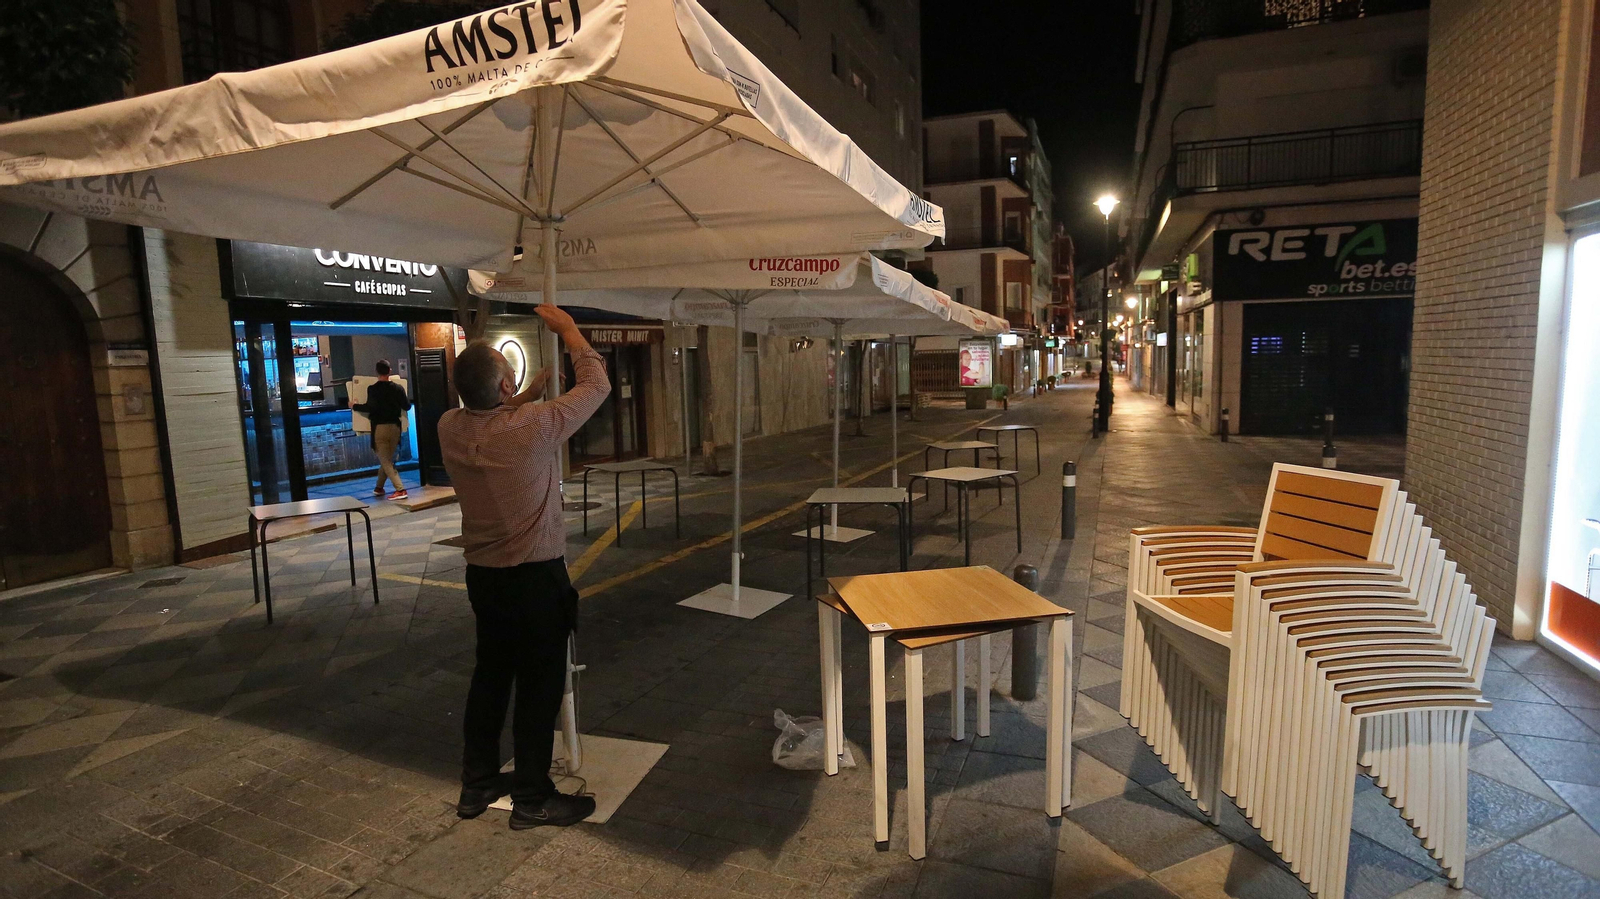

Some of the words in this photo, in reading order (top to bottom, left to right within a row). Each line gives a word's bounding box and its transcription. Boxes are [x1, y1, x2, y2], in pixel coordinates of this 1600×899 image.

[430, 75, 462, 91] 100%
[467, 67, 509, 84] MALTA
[514, 62, 531, 74] DE
[1228, 223, 1387, 272] RETA
[354, 280, 407, 296] CAFÉ&COPAS
[770, 276, 819, 287] ESPECIAL
[1307, 280, 1366, 297] sports
[1370, 278, 1415, 292] betti
[591, 329, 623, 342] MISTER
[626, 330, 649, 342] MINIT
